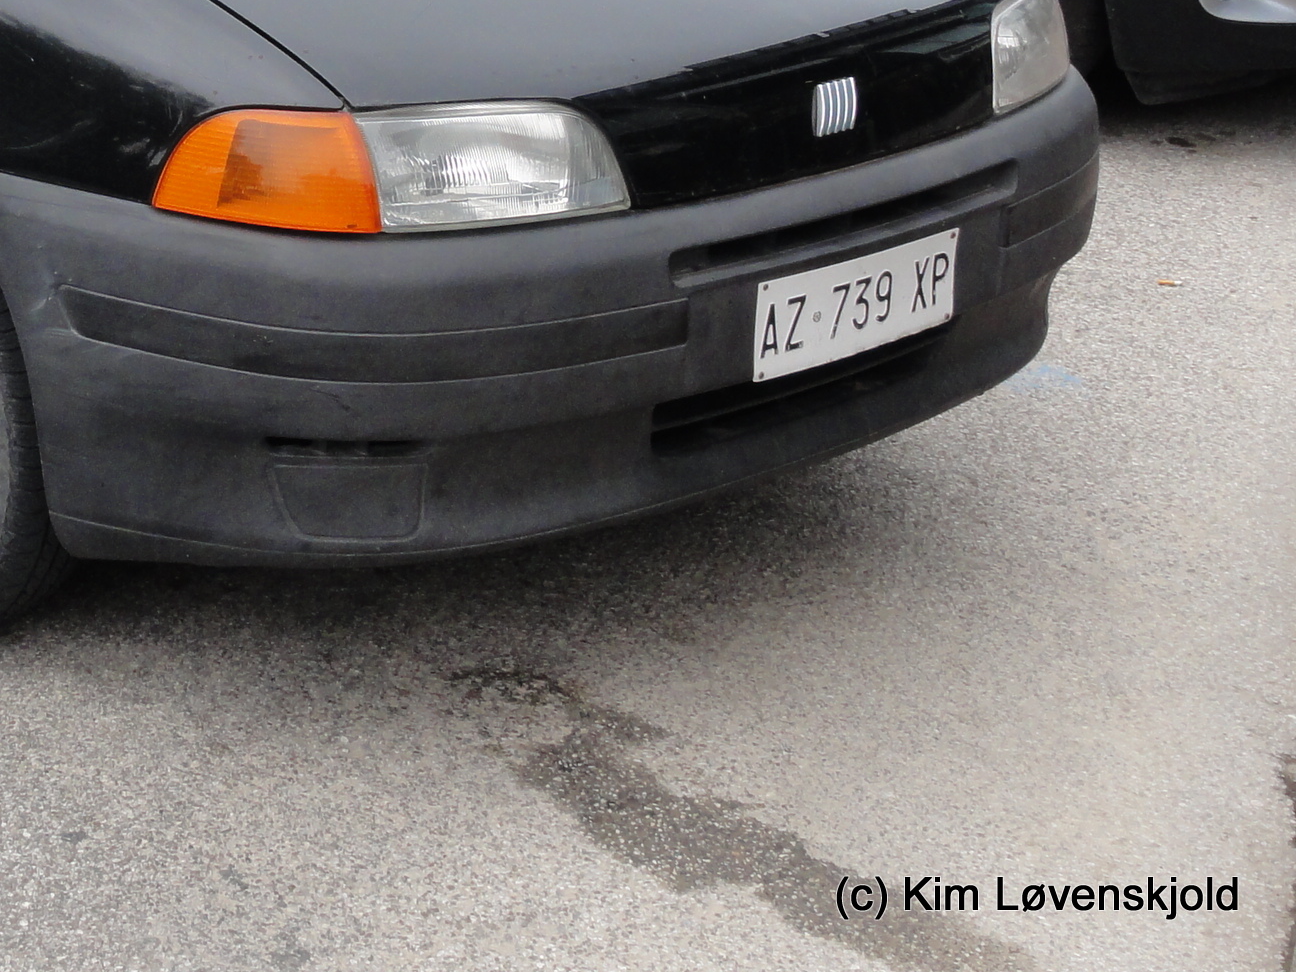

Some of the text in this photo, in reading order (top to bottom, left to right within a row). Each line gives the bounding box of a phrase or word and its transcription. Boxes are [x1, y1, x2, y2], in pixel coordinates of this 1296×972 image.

[760, 252, 950, 359] AZ 739 XP
